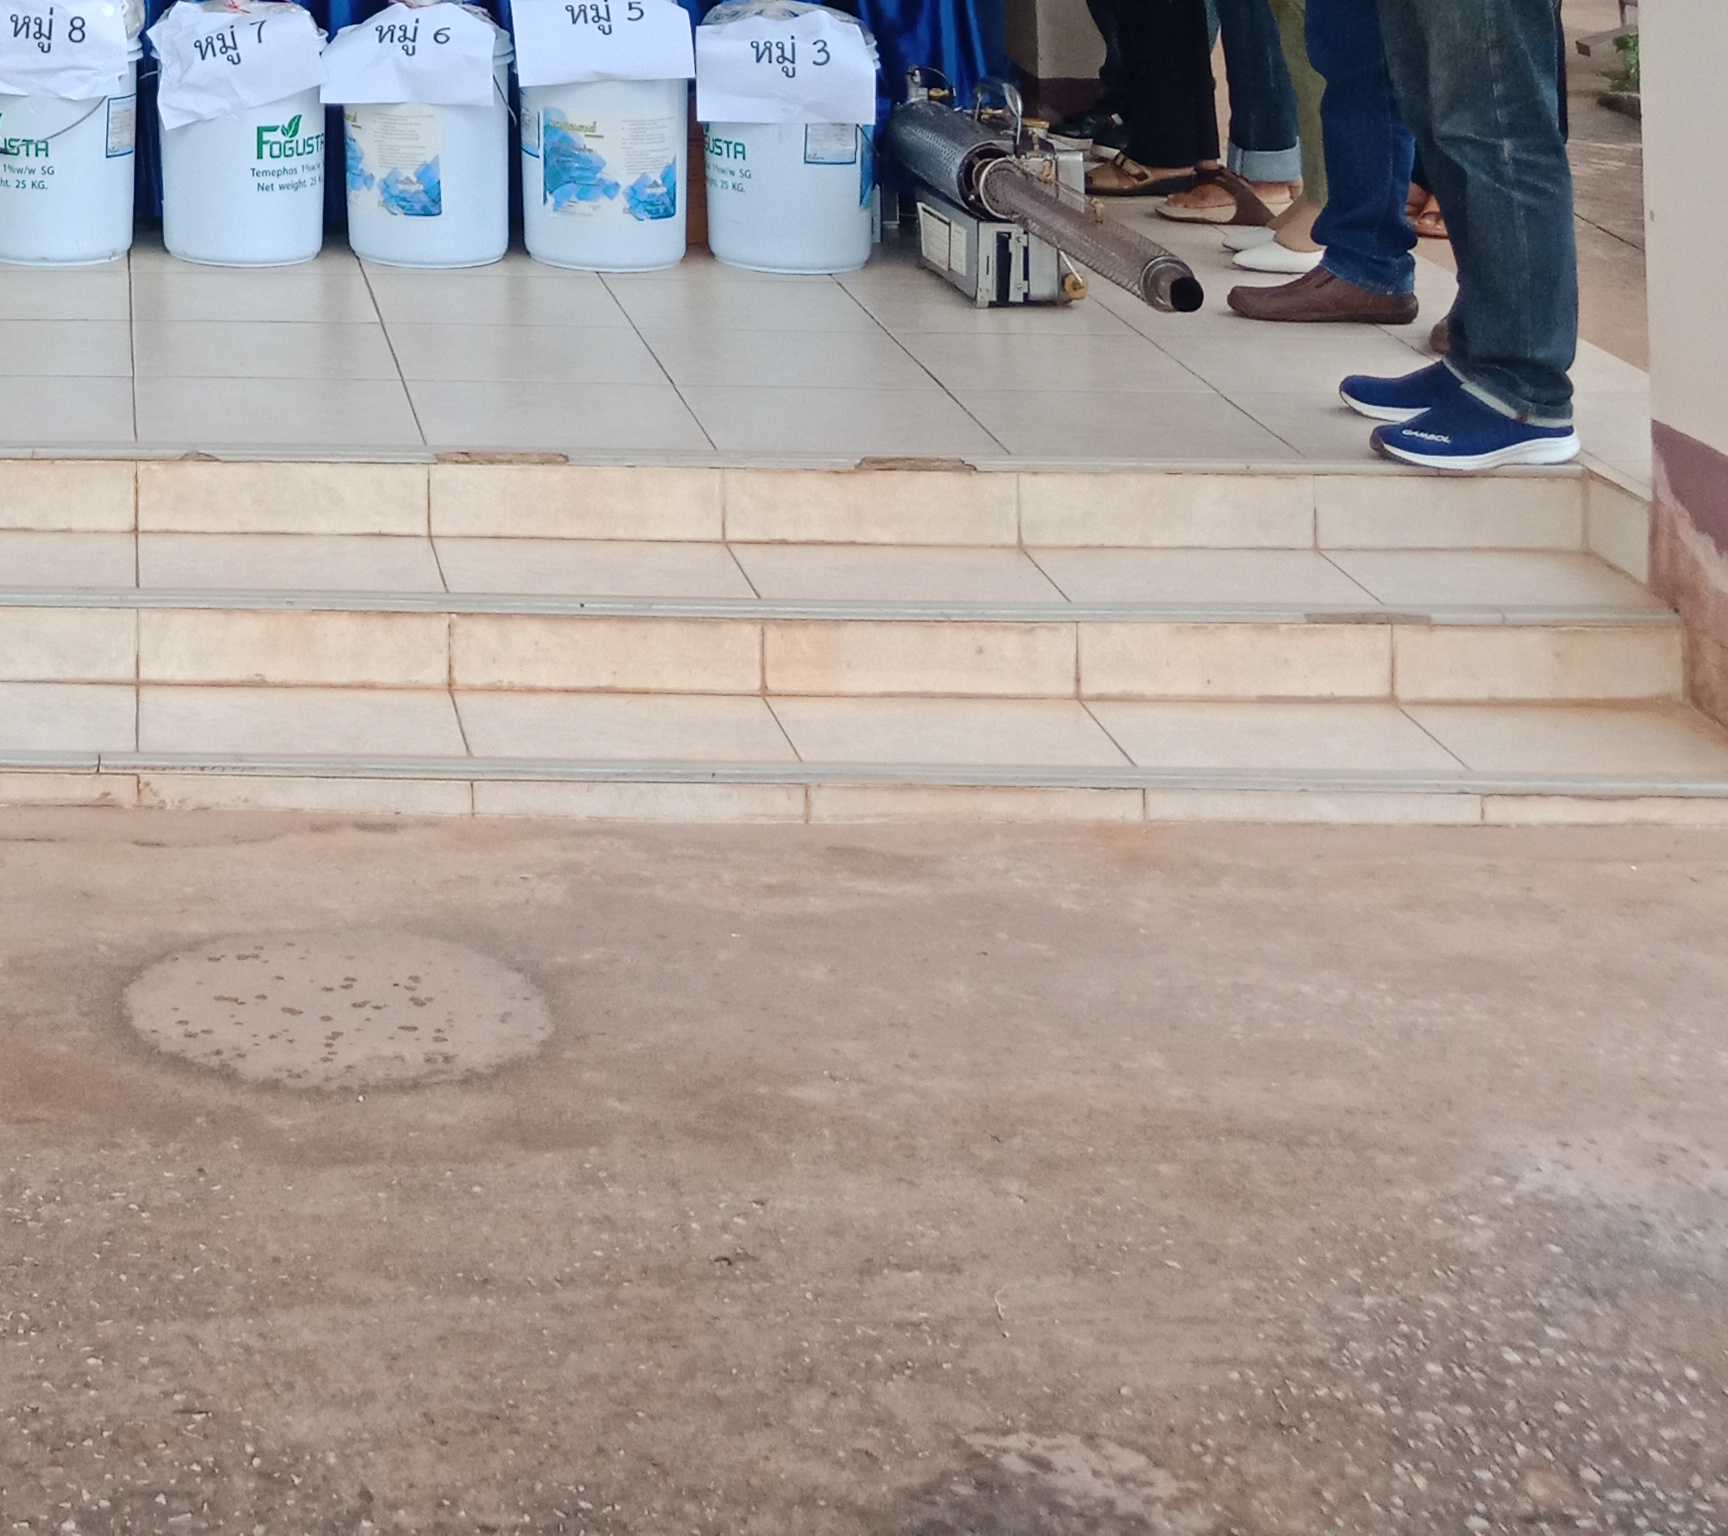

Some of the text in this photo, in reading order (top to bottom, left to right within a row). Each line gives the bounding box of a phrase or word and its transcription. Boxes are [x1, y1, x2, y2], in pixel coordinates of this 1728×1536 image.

[627, 1, 645, 22] 5
[10, 7, 86, 54] หมู่ 8
[375, 18, 451, 56] หมู่ 6
[194, 19, 267, 65] หมู่ 7
[750, 35, 830, 78] หมู่ 3
[41, 166, 54, 175] SG
[250, 166, 297, 177] Temephos
[739, 168, 751, 179] SG
[15, 180, 26, 188] 25
[257, 182, 274, 192] Net
